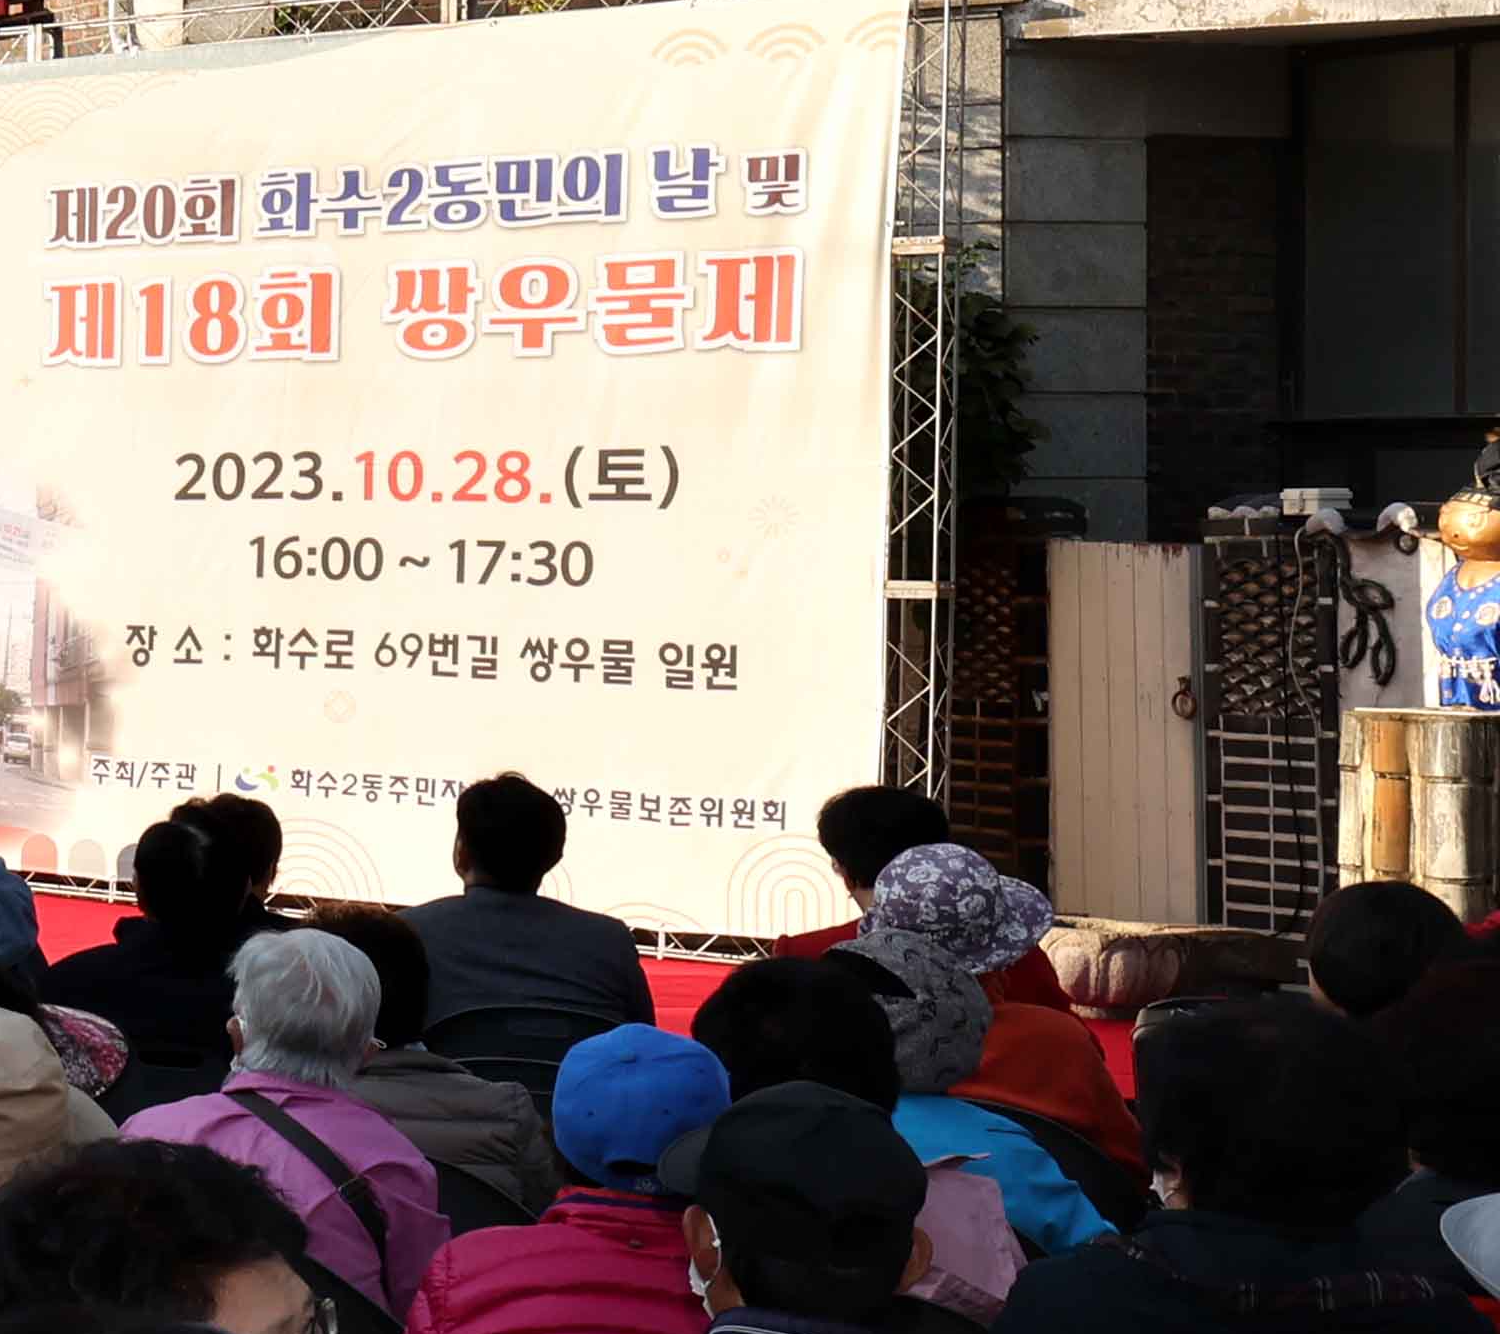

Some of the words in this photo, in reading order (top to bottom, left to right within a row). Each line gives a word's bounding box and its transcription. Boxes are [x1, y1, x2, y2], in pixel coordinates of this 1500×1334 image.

[50, 179, 235, 244] 제20회
[258, 152, 623, 233] 화수2동민의
[652, 146, 720, 214] 날
[746, 153, 801, 211] 및
[48, 272, 334, 362] 제18회
[389, 254, 796, 354] 쌍우물제
[249, 535, 384, 581] 16:00
[449, 539, 594, 587] 17:30
[125, 624, 157, 669] 장
[173, 626, 205, 666] 소
[252, 625, 356, 671] 화수로
[374, 631, 498, 680] 69번길
[520, 636, 635, 686] 쌍우물
[658, 642, 739, 692] 일원
[91, 756, 198, 791] 주최/주관
[551, 785, 788, 831] 쌍우물보존위원회
